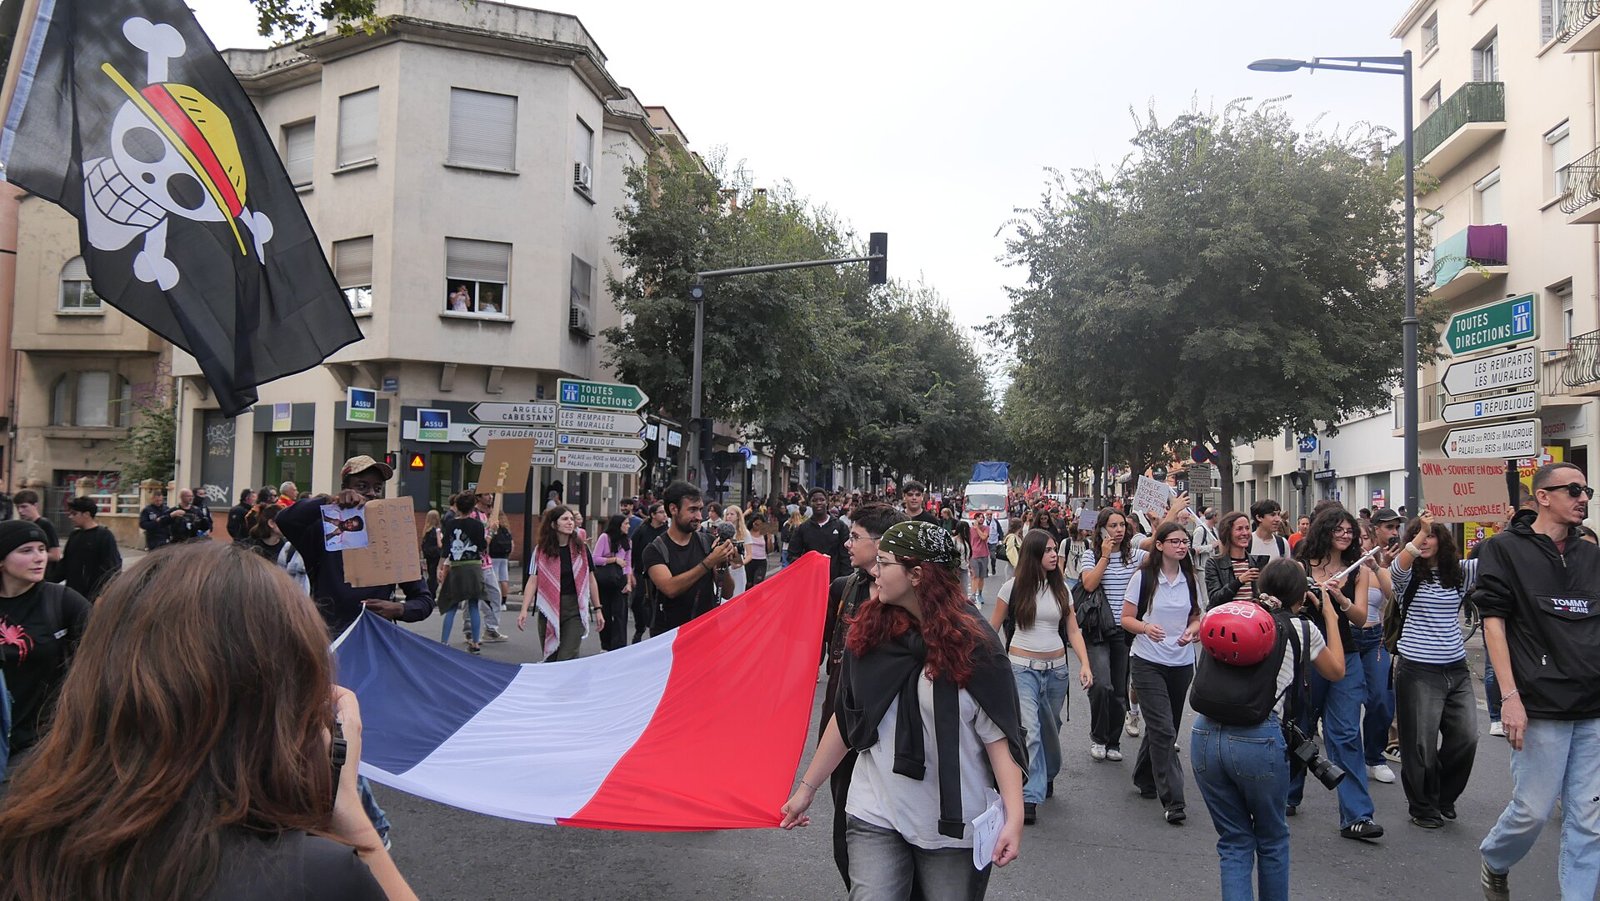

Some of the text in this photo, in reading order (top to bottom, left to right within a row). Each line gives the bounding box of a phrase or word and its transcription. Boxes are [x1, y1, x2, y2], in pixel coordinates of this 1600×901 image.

[1456, 313, 1488, 332] TOUTES
[1456, 324, 1511, 349] DIRECTIONS
[1474, 352, 1532, 374] LES REMPARTS
[1475, 366, 1532, 387] LES MURALLES
[580, 385, 613, 395] TOUTES
[580, 394, 633, 407] DIRECTIONS
[1484, 396, 1533, 414] RÉPUBLIQUE
[577, 413, 615, 422] REMPARTS
[577, 421, 614, 430] MURALLES
[500, 430, 554, 438] GAUDÉRIQUE
[1458, 434, 1476, 444] PALAIS
[1483, 432, 1496, 441] ROIS
[1502, 428, 1533, 439] MAJORQUE
[570, 436, 616, 446] RÉPUBLIQUE
[1458, 446, 1474, 455] PALAU
[1484, 444, 1496, 453] REIS
[1502, 440, 1532, 451] MALLORCA
[1448, 465, 1476, 475] SOUVENT
[1476, 464, 1486, 474] EN
[1487, 465, 1504, 476] COURS
[1453, 482, 1476, 496] QUE
[1551, 598, 1588, 608] TOMMY
